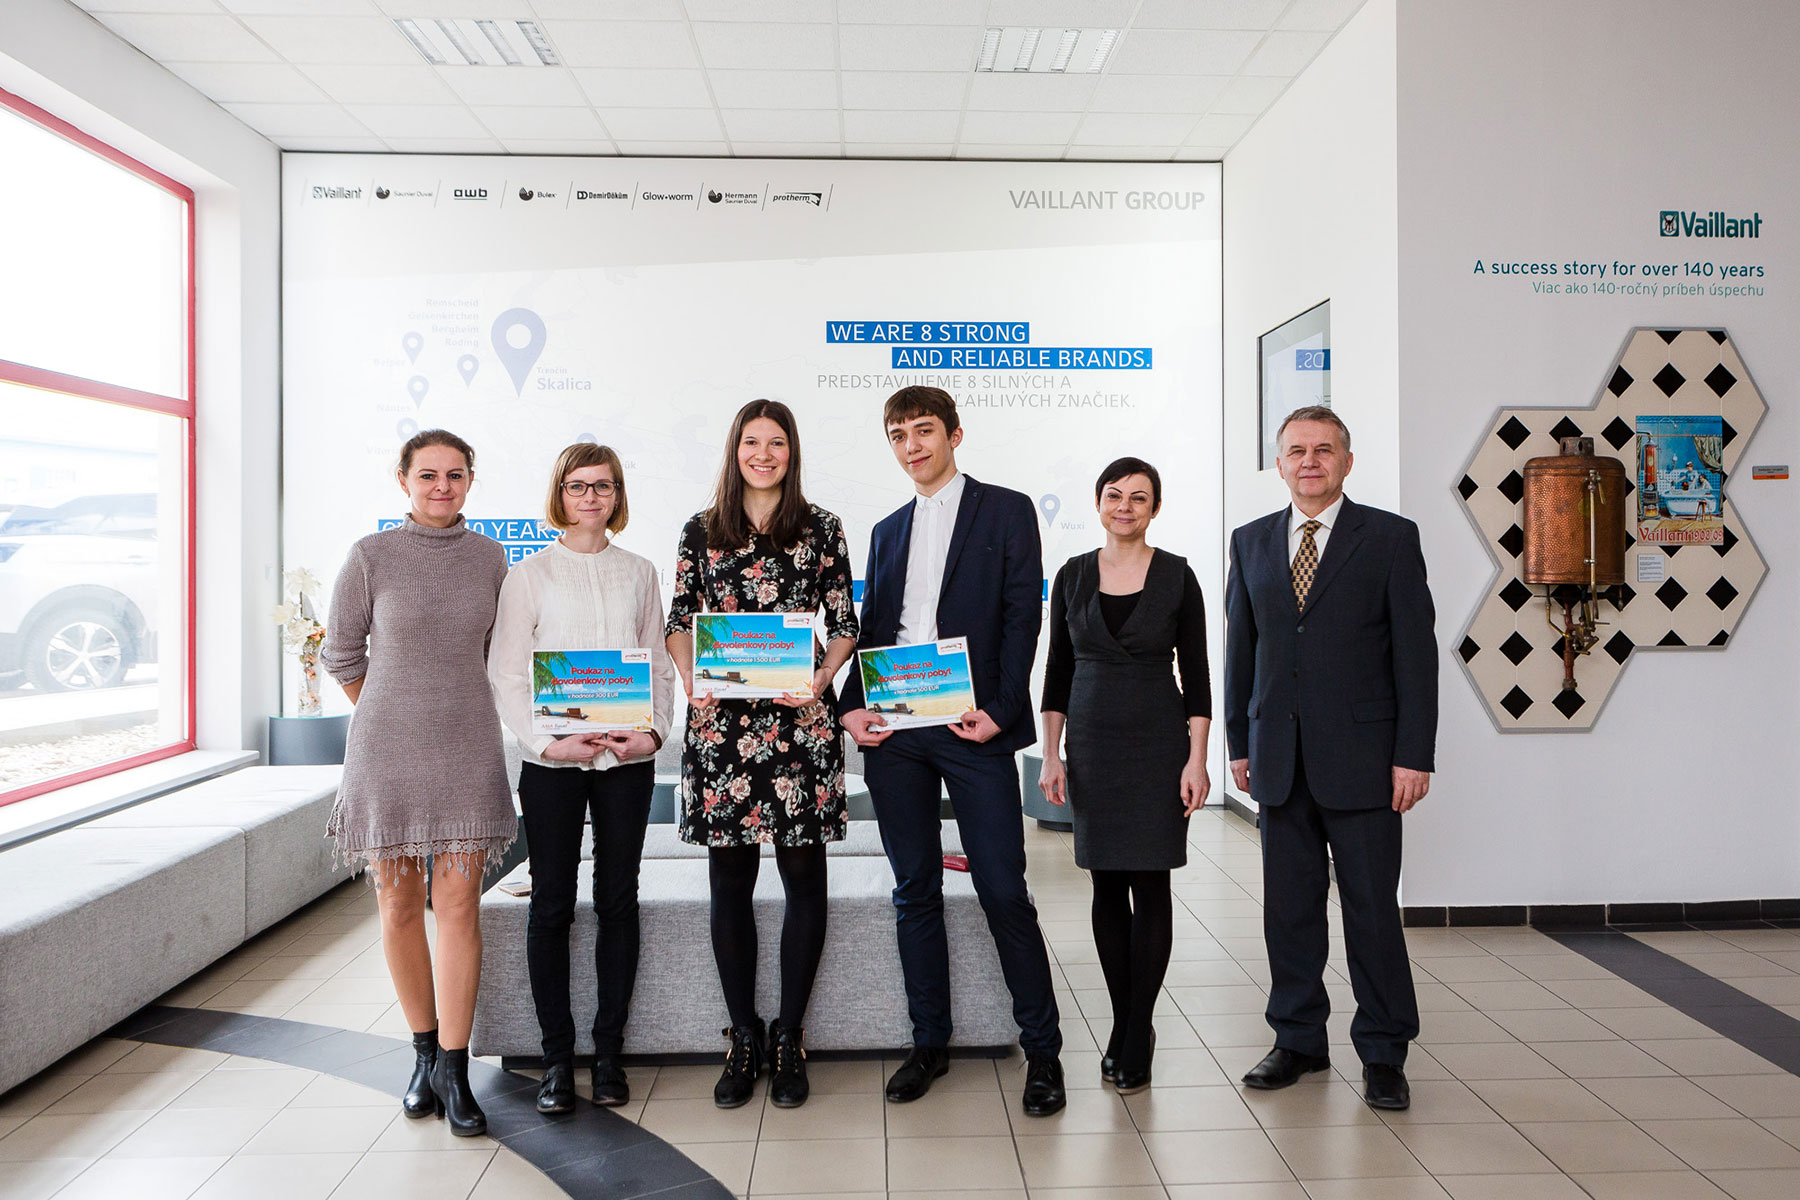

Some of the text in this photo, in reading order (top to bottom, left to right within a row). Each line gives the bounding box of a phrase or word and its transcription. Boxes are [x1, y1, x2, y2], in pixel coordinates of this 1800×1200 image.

[323, 187, 362, 199] Vaillant
[773, 193, 810, 202] protherm
[1009, 190, 1205, 210] VAILLANT GROUP
[1681, 211, 1763, 238] Vaillant
[1473, 260, 1765, 278] A success story for over 140 years
[1532, 281, 1764, 298] Viac ako 140-ročný príbeh úspechu
[831, 324, 1026, 342] WE ARE 8 STRONG
[897, 350, 1151, 368] AND RELIABLE BRANDS.
[537, 377, 592, 391] Skalica
[818, 371, 1072, 389] PREDSTAVUJEME 8 SILNÝCH A
[954, 390, 1136, 408] ĽAHLIVÝCH ZNAČIEK.
[1060, 521, 1085, 530] Wuxi
[1639, 527, 1690, 542] Vaillant
[732, 631, 764, 639] Poukaz
[712, 640, 794, 650] dovolenkový pobyt
[571, 667, 602, 675] Poukaz
[893, 661, 933, 672] Poukaz na
[551, 676, 634, 685] dovolenkový pobyt
[878, 667, 952, 683] dovolenkový pobyt
